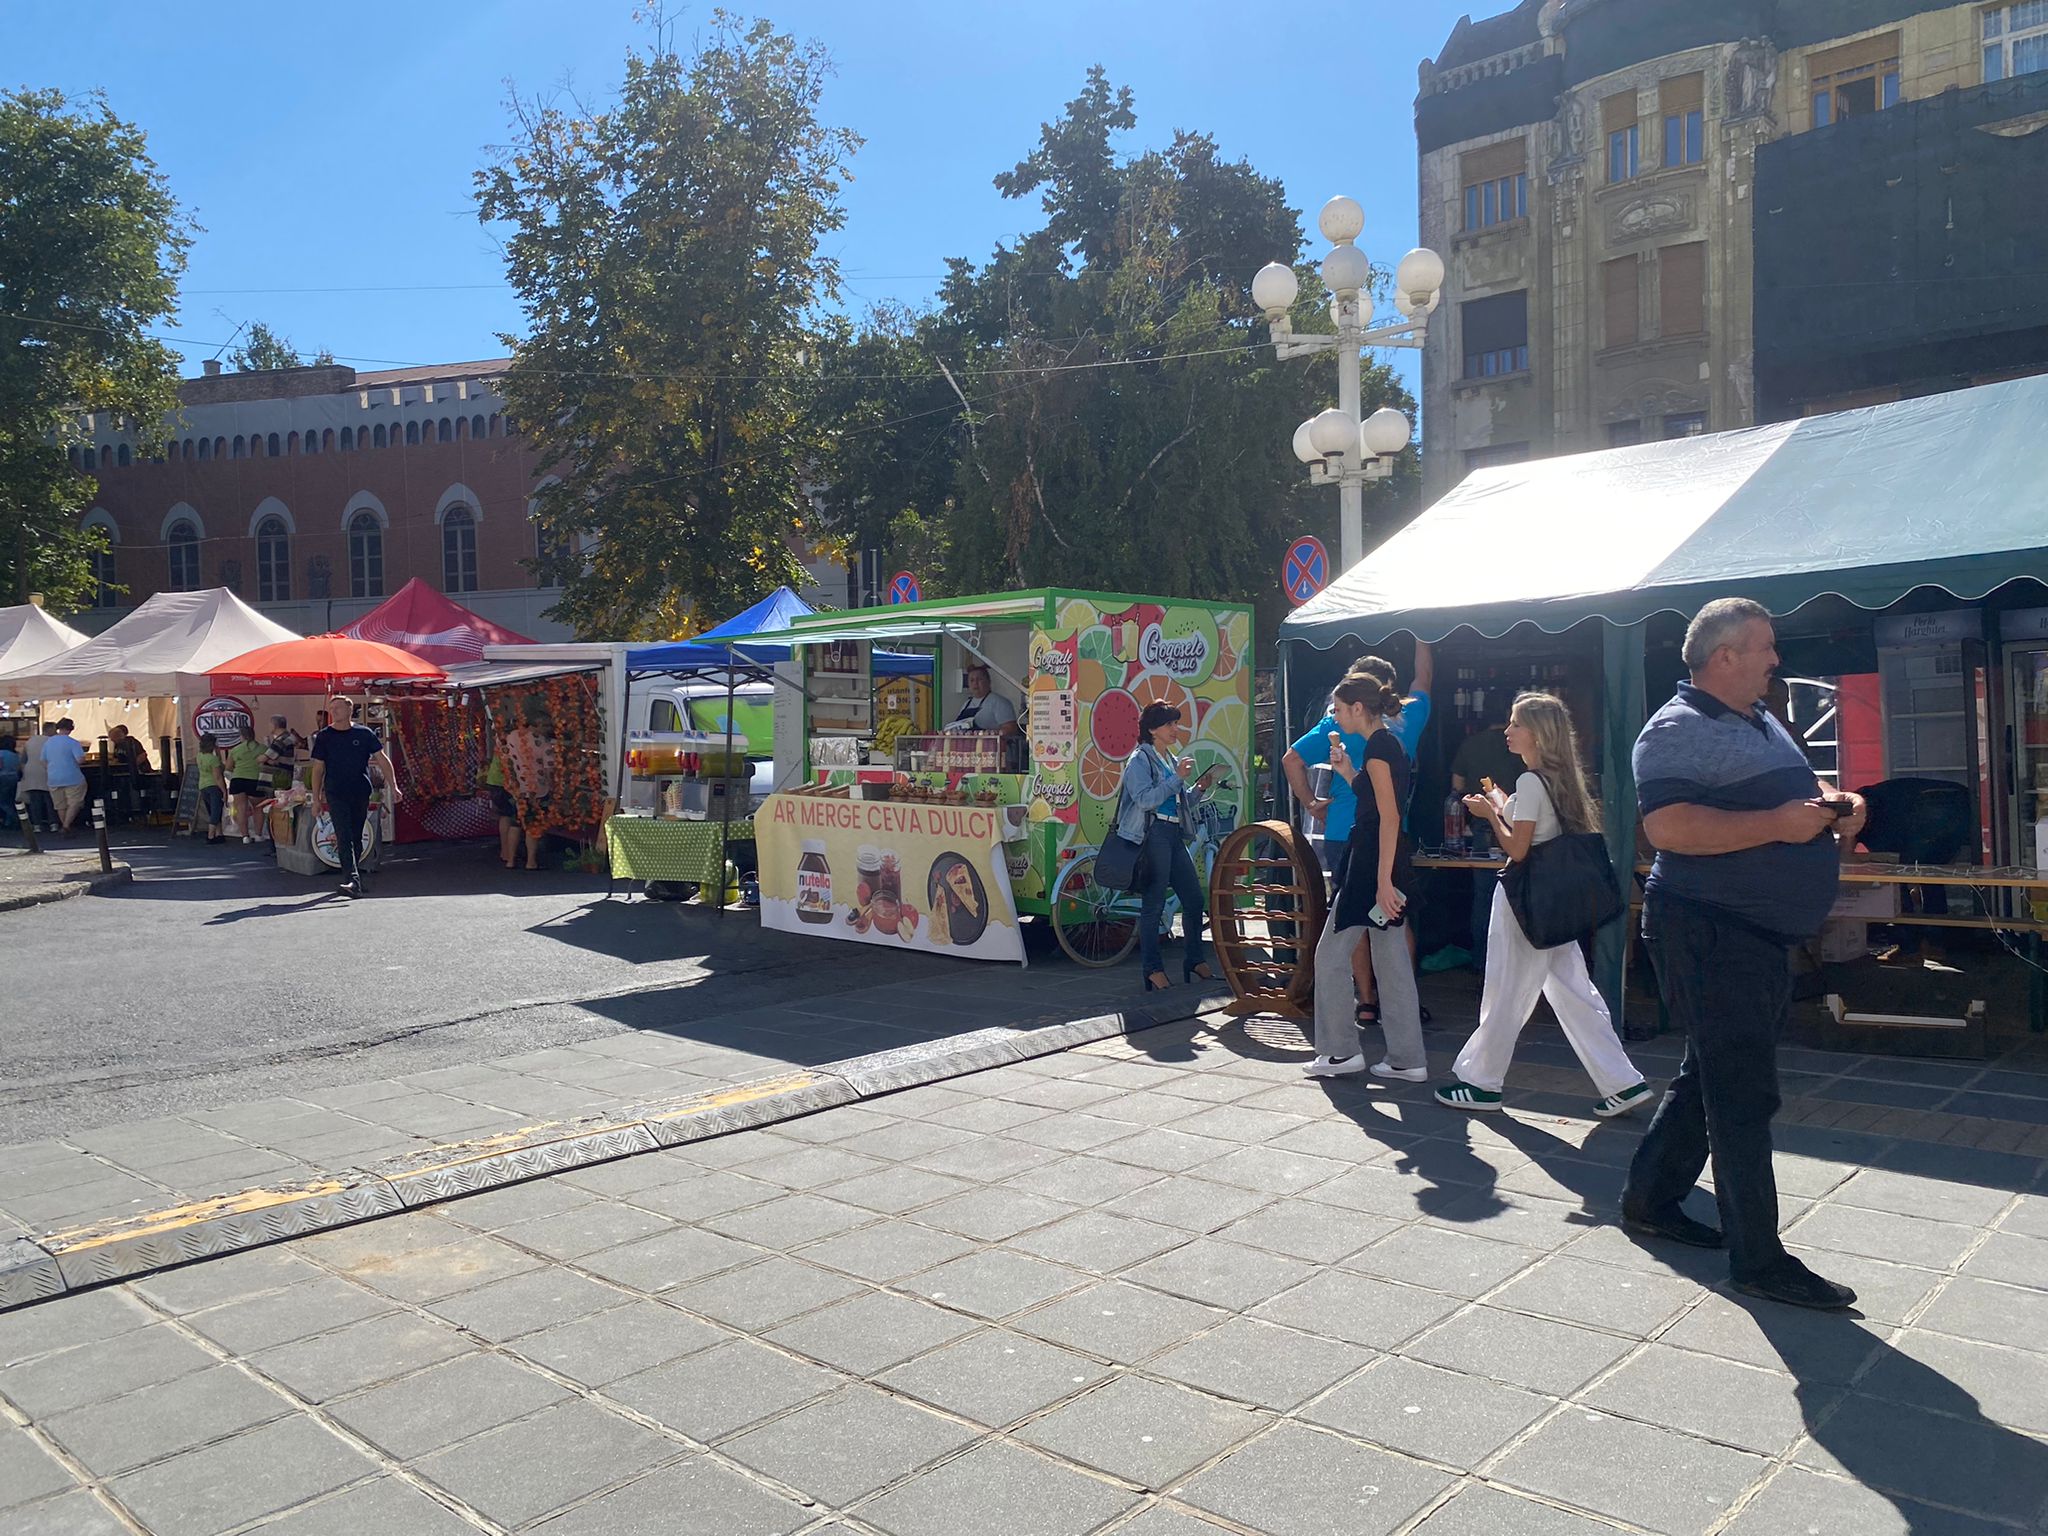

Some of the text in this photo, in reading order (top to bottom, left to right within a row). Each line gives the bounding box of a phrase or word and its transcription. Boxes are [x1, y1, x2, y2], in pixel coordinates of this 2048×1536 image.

[1033, 645, 1074, 670] Gogosele
[1145, 629, 1205, 666] Gogosele
[1032, 774, 1074, 801] Gogosele
[773, 800, 796, 824] AR
[801, 801, 862, 829] MERGE
[867, 805, 923, 834] CEVA
[799, 873, 831, 889] nutella
